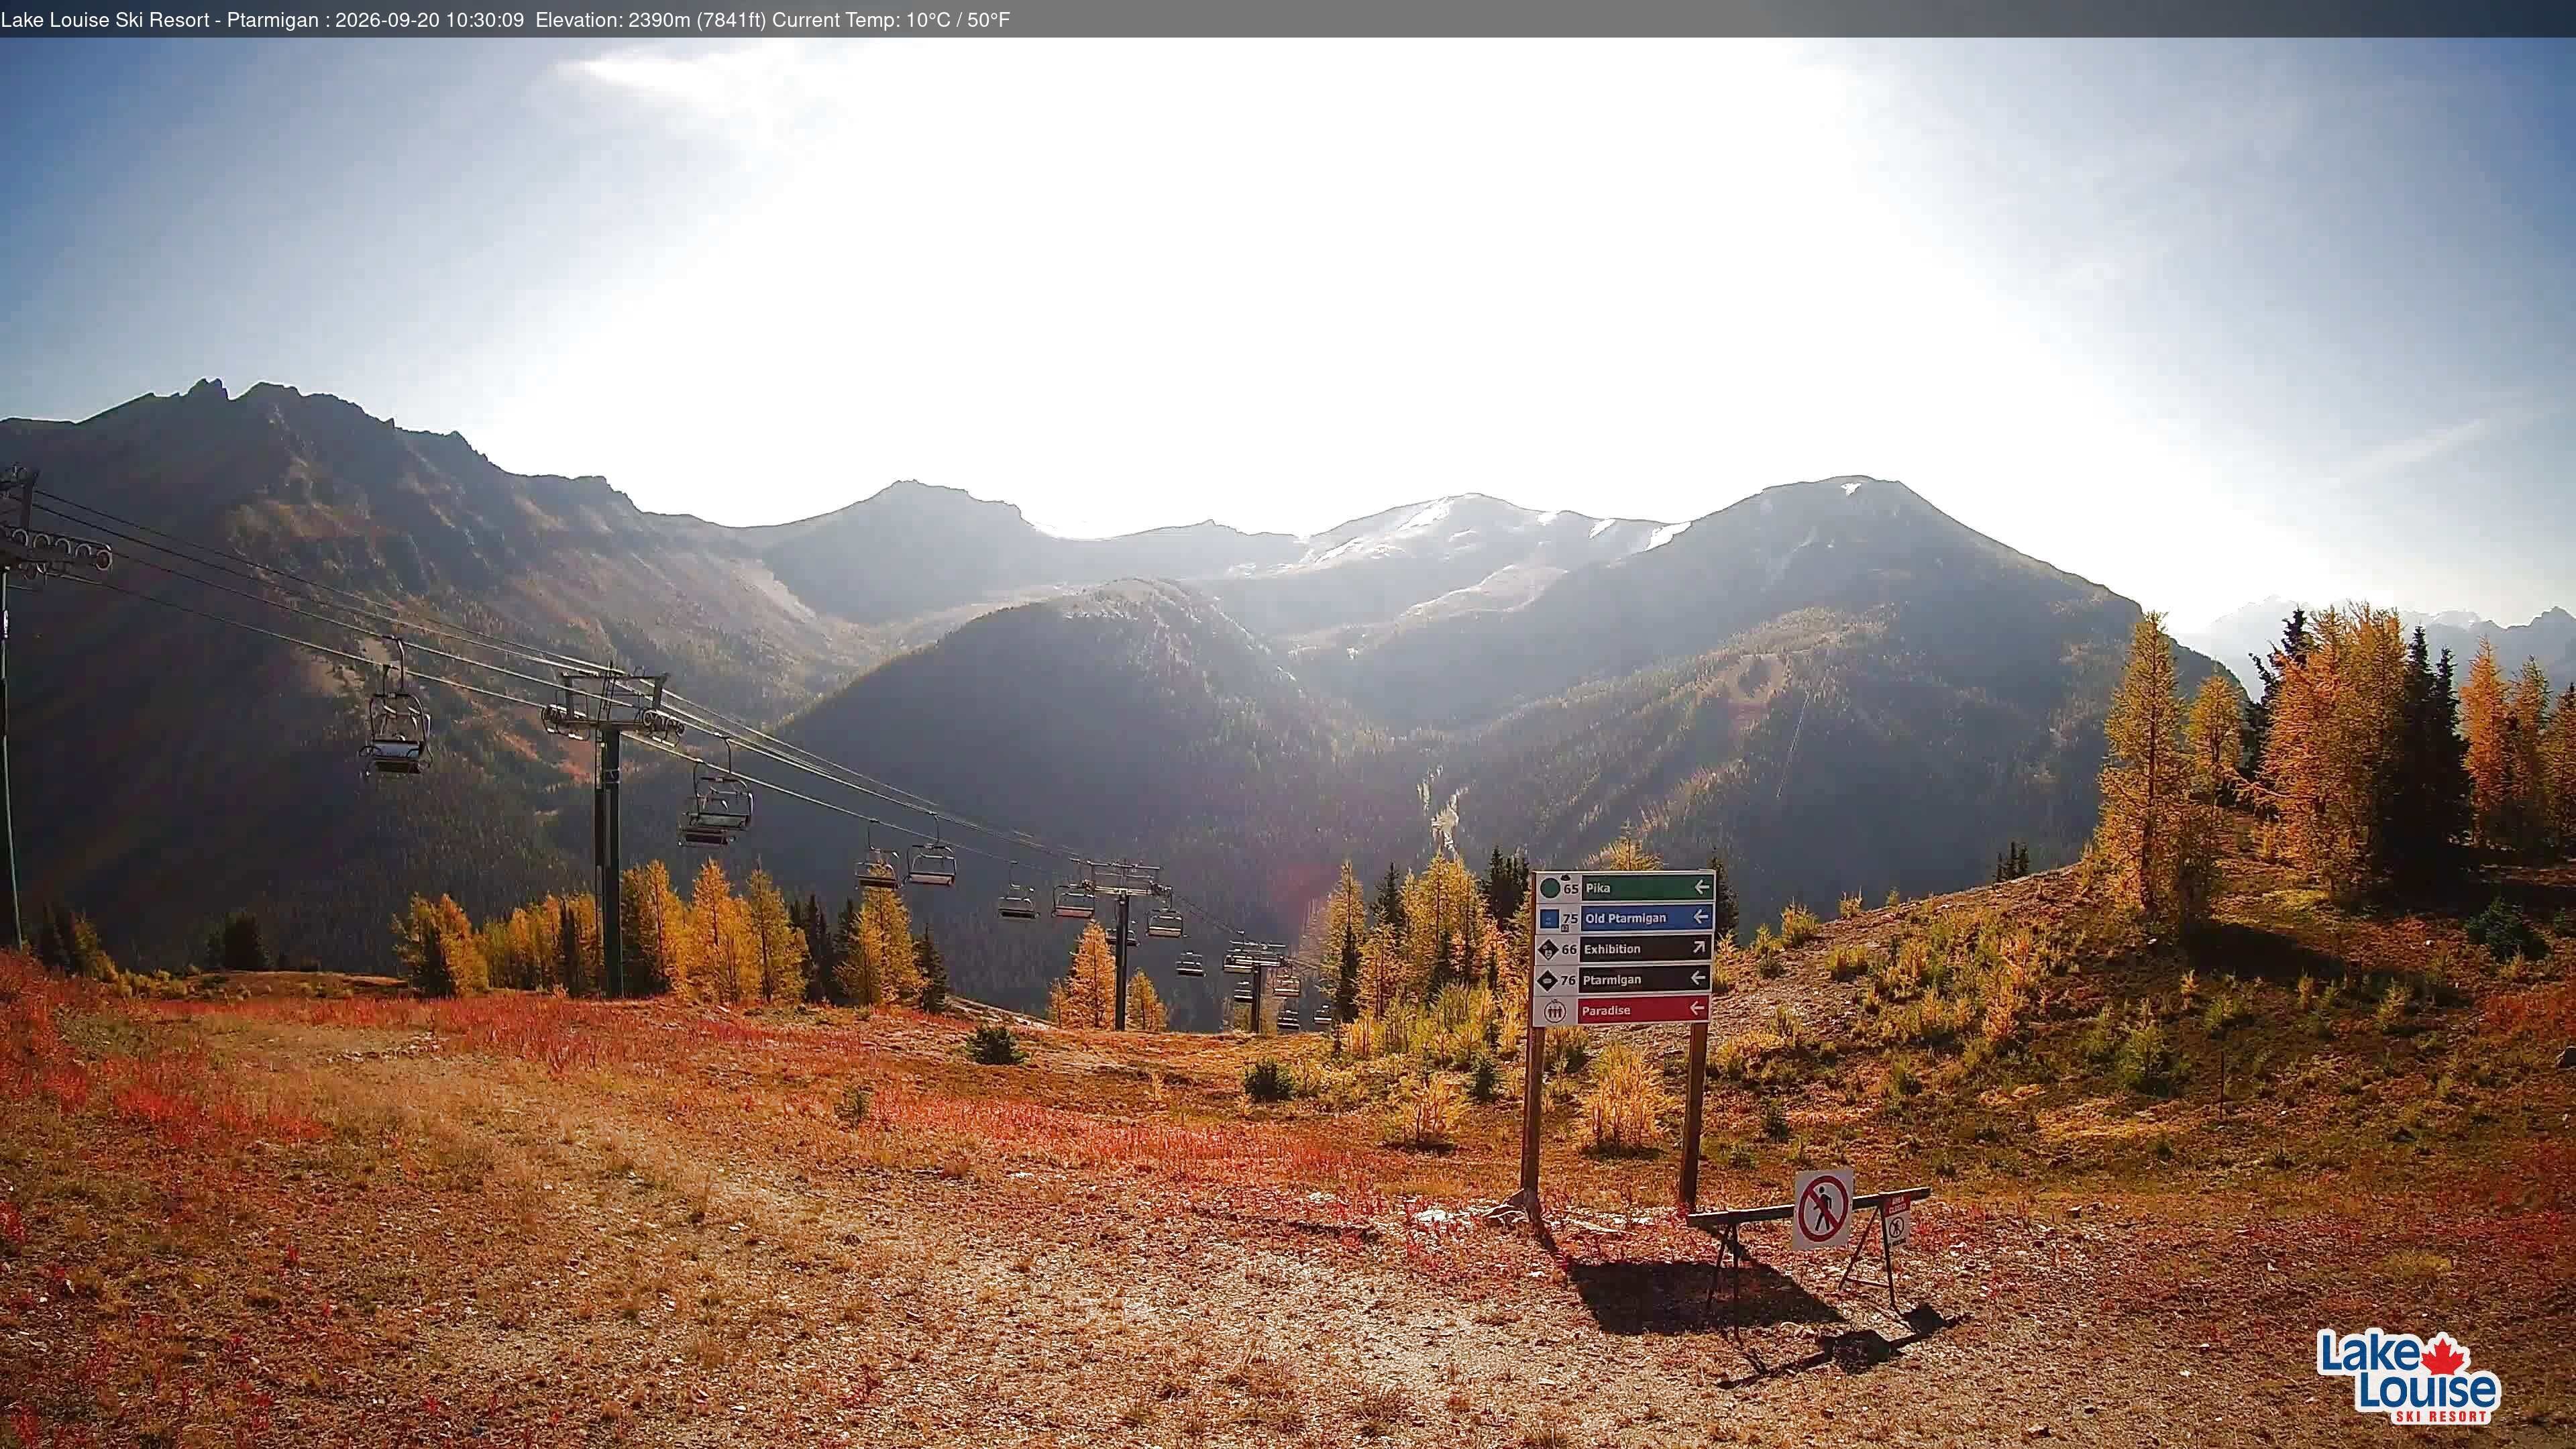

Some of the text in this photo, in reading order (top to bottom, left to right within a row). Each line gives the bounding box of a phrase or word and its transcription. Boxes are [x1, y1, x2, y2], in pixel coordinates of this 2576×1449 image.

[1564, 883, 1611, 894] 65 Pika
[1563, 913, 1666, 925] 75 Old Ptarmigan
[1562, 944, 1641, 955] 66 Exhibition
[1560, 974, 1642, 986] 76 Ptarmigan
[1582, 1006, 1631, 1016] Paradise
